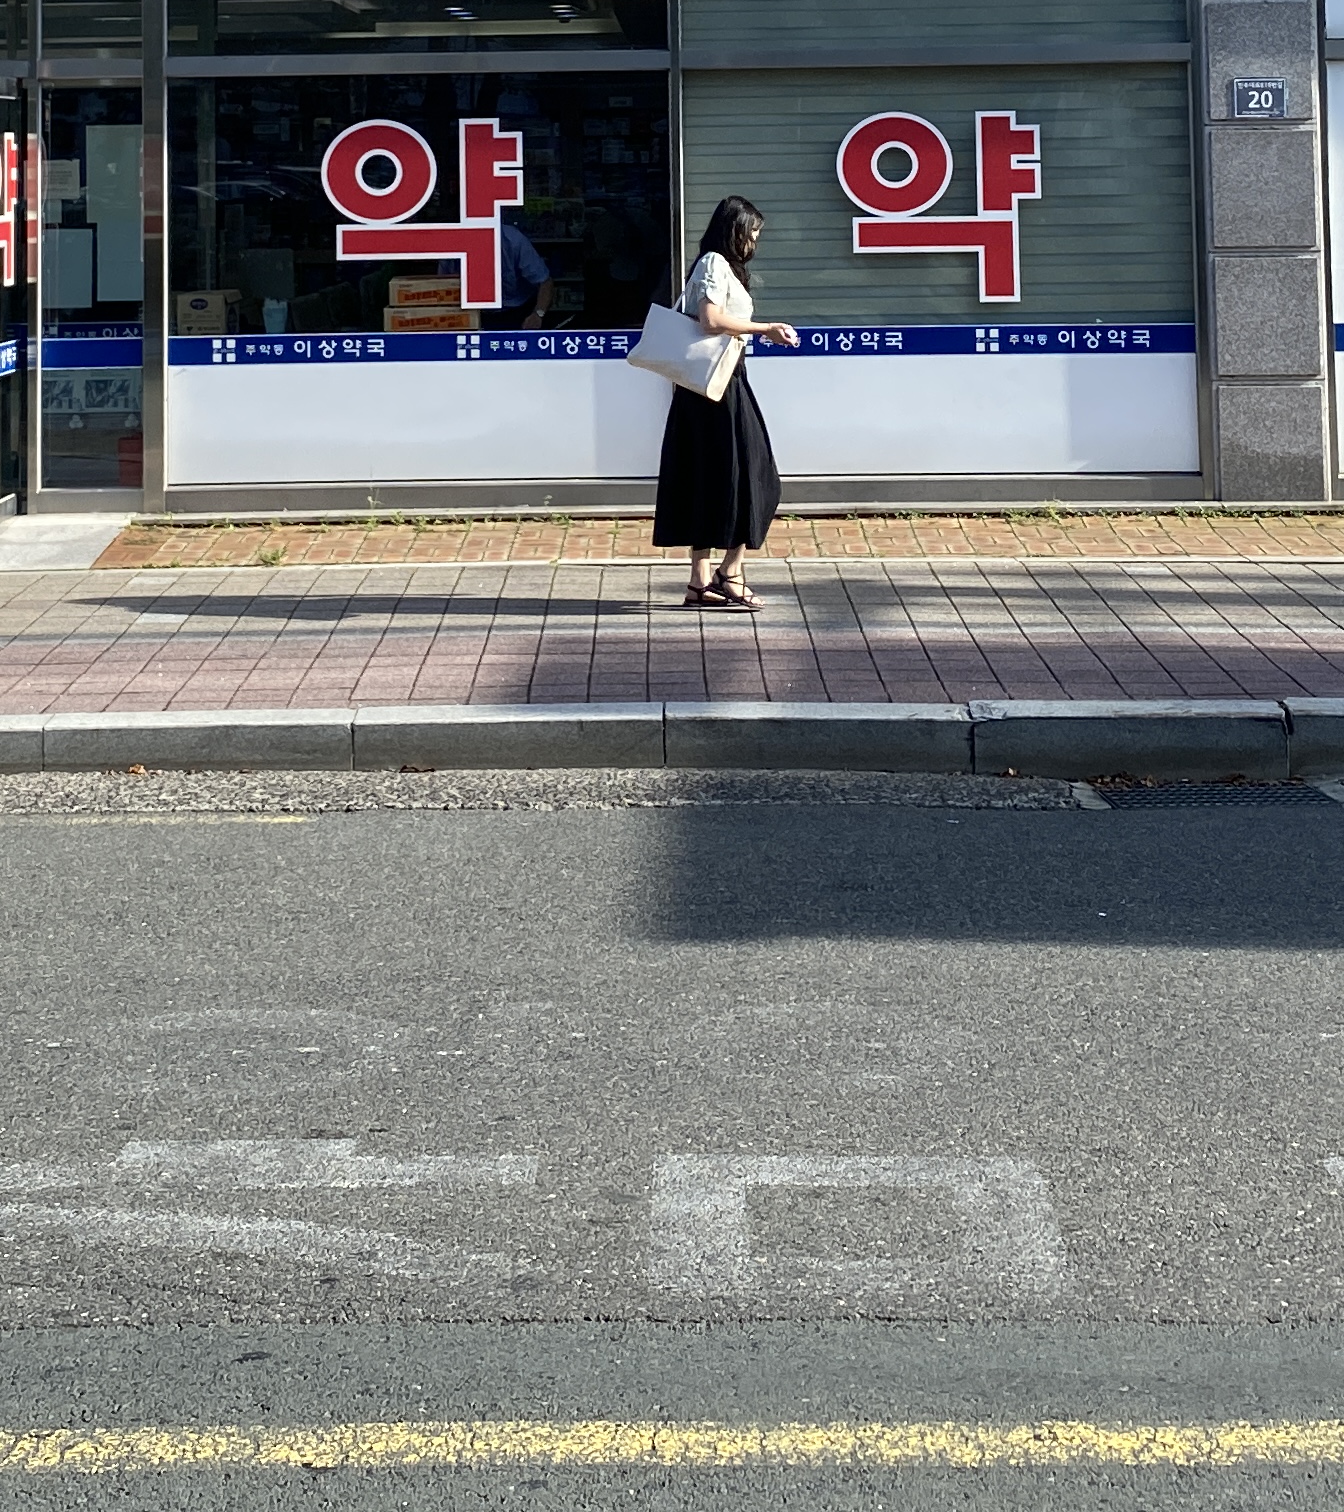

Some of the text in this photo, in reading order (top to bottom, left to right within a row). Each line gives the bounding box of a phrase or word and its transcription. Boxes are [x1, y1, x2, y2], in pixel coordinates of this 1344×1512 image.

[1248, 90, 1273, 109] 20
[321, 118, 524, 309] 약
[836, 110, 1042, 303] 약
[293, 338, 385, 358] 이상약국
[537, 336, 629, 354] 이상약국
[811, 332, 903, 351] 이상약국
[1057, 330, 1151, 349] 이상약국
